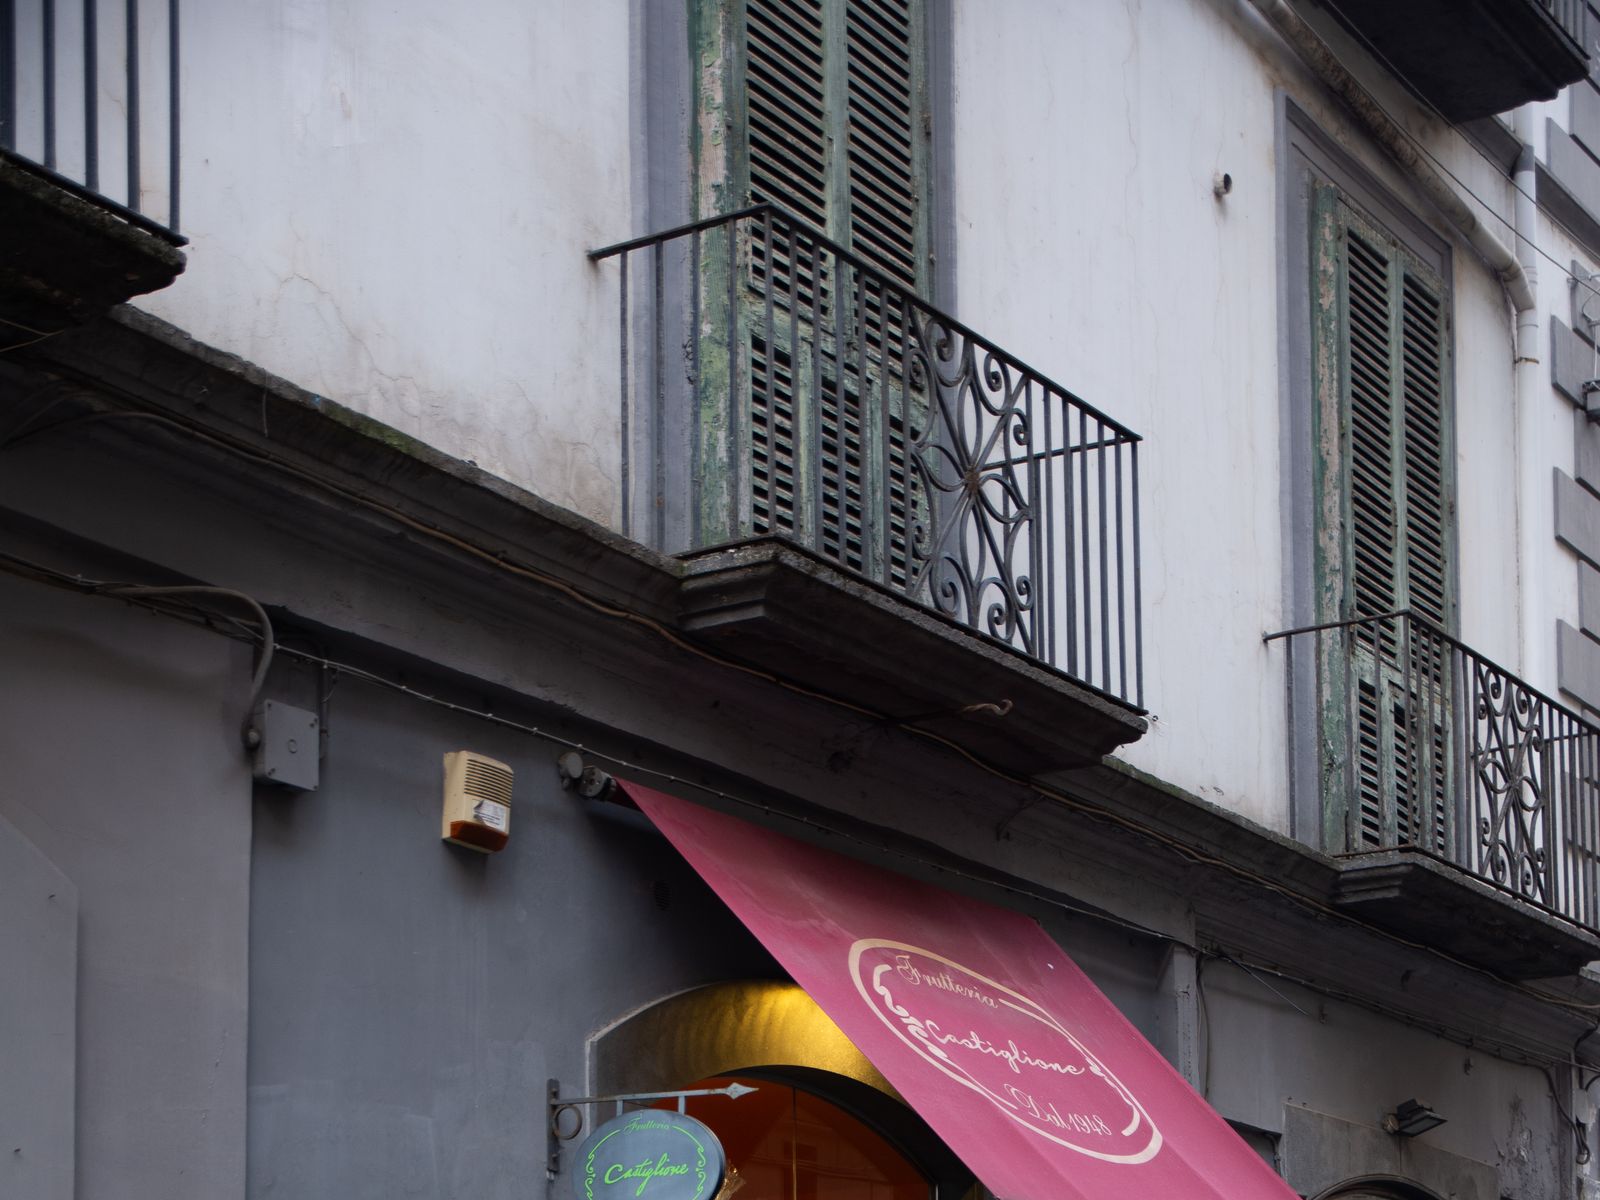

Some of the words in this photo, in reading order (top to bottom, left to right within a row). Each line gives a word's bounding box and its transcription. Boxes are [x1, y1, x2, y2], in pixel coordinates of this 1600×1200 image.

[896, 955, 998, 1009] Frutteria
[925, 1019, 1085, 1074] Castiglione
[1004, 1083, 1069, 1129] Dal
[1068, 1112, 1112, 1136] 1948
[604, 1152, 689, 1197] Castiglione
